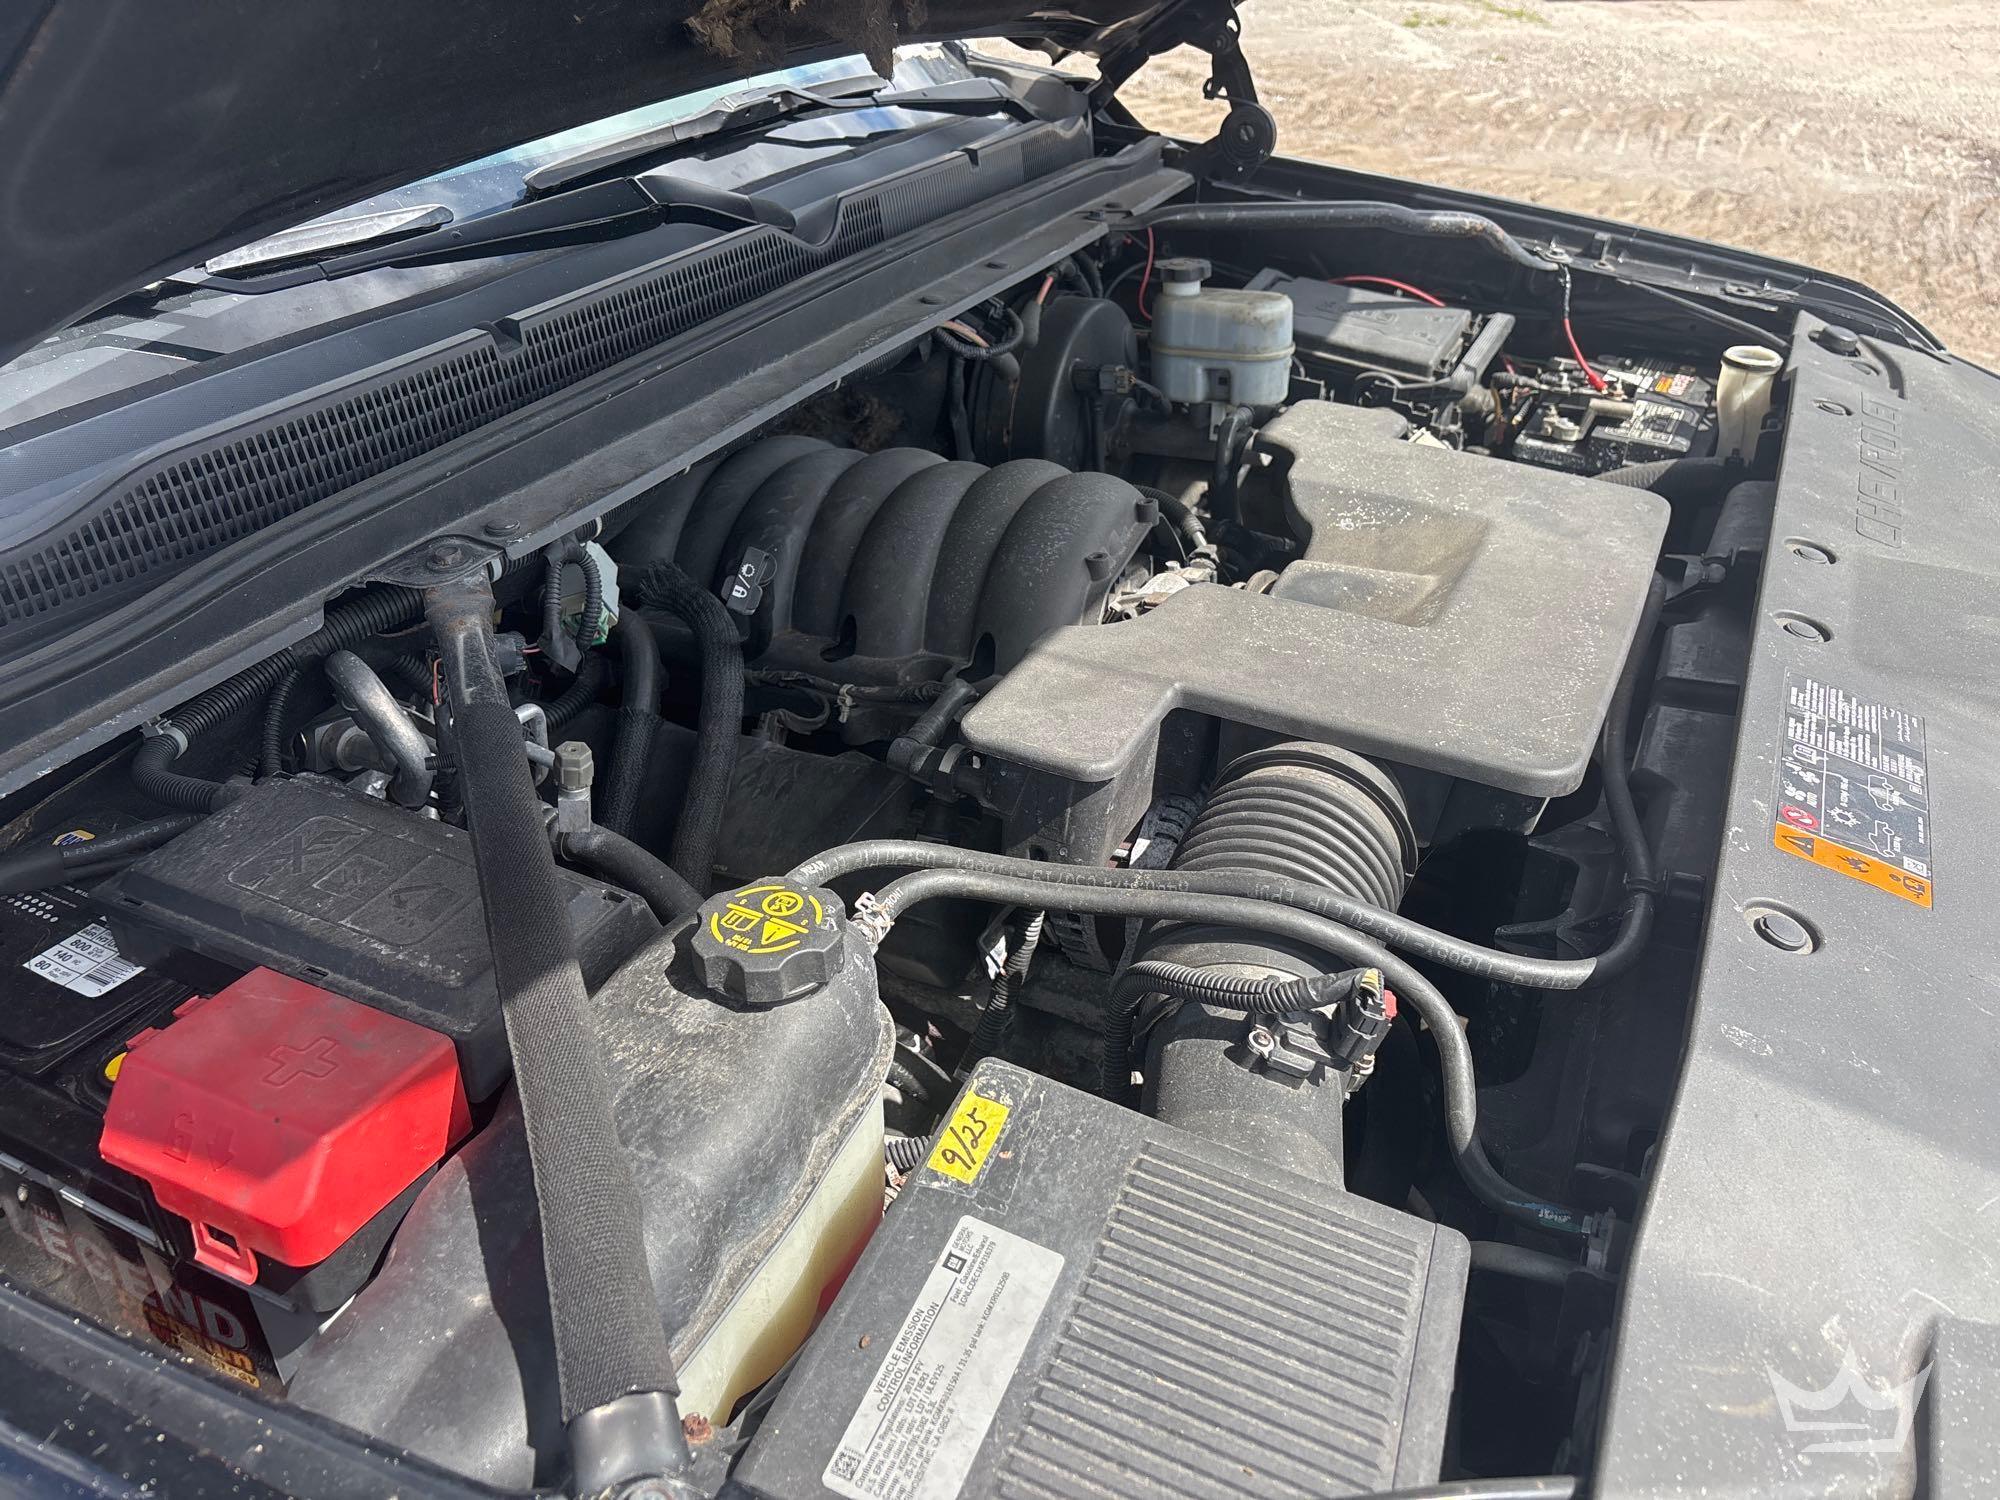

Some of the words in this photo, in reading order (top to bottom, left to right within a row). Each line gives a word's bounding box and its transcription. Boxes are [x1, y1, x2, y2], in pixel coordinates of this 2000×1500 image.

[1855, 391, 1901, 547] CHEVROLET
[800, 859, 826, 877] REAR
[52, 950, 73, 962] 140
[70, 939, 91, 952] 800
[34, 960, 51, 971] 80
[941, 1107, 987, 1171] 9/25
[952, 1225, 967, 1249] GENERAL
[959, 1229, 973, 1252] MOTORS
[965, 1243, 974, 1254] LLC
[950, 1286, 962, 1303] Fuel:
[874, 1352, 900, 1395] VEHICLE
[897, 1308, 925, 1353] EMISSION
[876, 1364, 907, 1412] CONTROL
[901, 1301, 939, 1365] INFORMATION
[959, 1348, 972, 1367] 31-35
[968, 1337, 978, 1350] gal
[973, 1320, 986, 1338] tank:
[903, 1376, 916, 1394] 2019
[913, 1359, 924, 1375] FFV
[916, 1398, 927, 1414] LDT
[925, 1363, 945, 1395] ULEV125
[905, 1396, 917, 1413] LDT
[916, 1372, 929, 1393] TIER3
